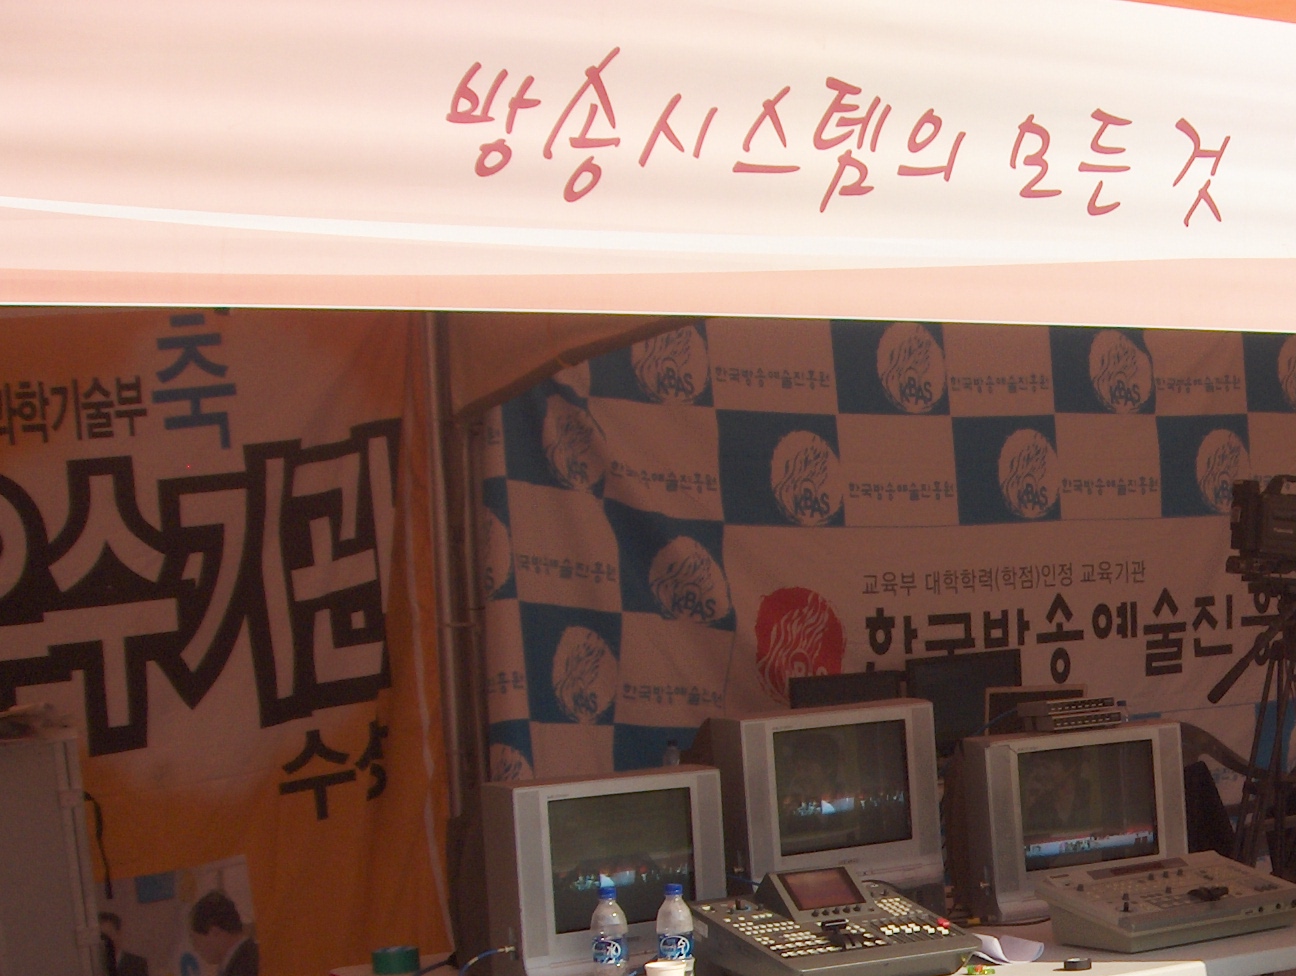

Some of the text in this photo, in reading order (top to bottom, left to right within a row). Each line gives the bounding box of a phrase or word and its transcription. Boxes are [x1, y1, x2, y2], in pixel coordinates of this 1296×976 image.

[446, 46, 1230, 227] 방송시스템의 모든 것
[152, 313, 236, 449] 축
[862, 560, 1147, 597] 교육부 대학학력(학점)인정 교육기관
